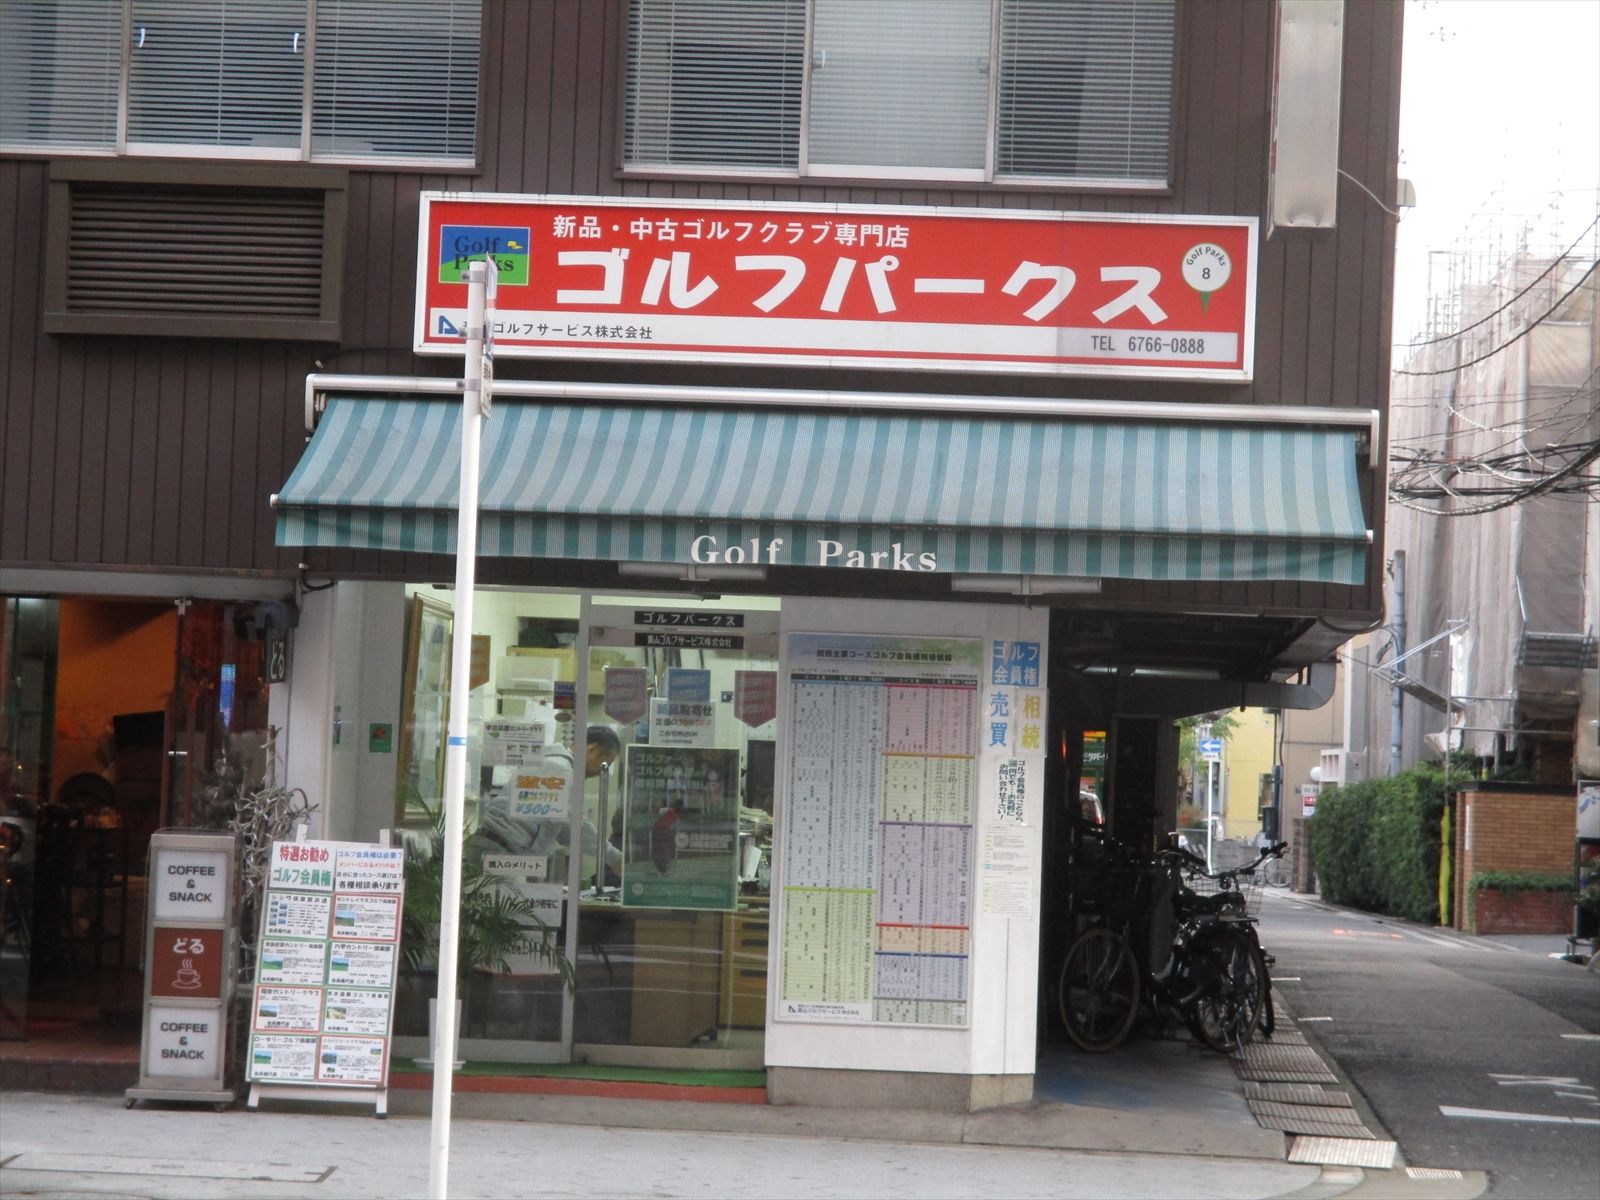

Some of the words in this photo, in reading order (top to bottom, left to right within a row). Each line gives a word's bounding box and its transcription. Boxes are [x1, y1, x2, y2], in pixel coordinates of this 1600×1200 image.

[552, 214, 910, 249] 新品・中古ゴルフクラブ専門店
[454, 235, 500, 253] Golf
[454, 253, 514, 272] Pks
[1186, 246, 1203, 266] Golf
[1205, 246, 1226, 267] Parks
[1202, 267, 1211, 280] 8
[556, 247, 1169, 325] ゴルフパークス
[462, 321, 653, 340] ゴルフサービス株式会社
[1091, 335, 1116, 351] TEL
[1128, 336, 1205, 354] 6766-0888
[690, 535, 784, 565] Golf
[818, 539, 938, 573] Parks
[270, 640, 285, 680] どる
[993, 643, 1038, 662] ゴルフ
[993, 664, 1038, 686] 会員権
[988, 691, 1009, 748] 売買
[1021, 695, 1041, 750] 相続
[280, 845, 329, 862] 特選お勧め
[168, 865, 215, 876] COFFEE
[273, 867, 331, 886] ゴルフ会員権
[187, 880, 195, 889] &
[168, 891, 212, 903] SNACK
[173, 938, 204, 954] どる
[160, 1022, 208, 1033] COFFEE
[179, 1037, 188, 1046] &
[161, 1049, 204, 1060] SNACK
